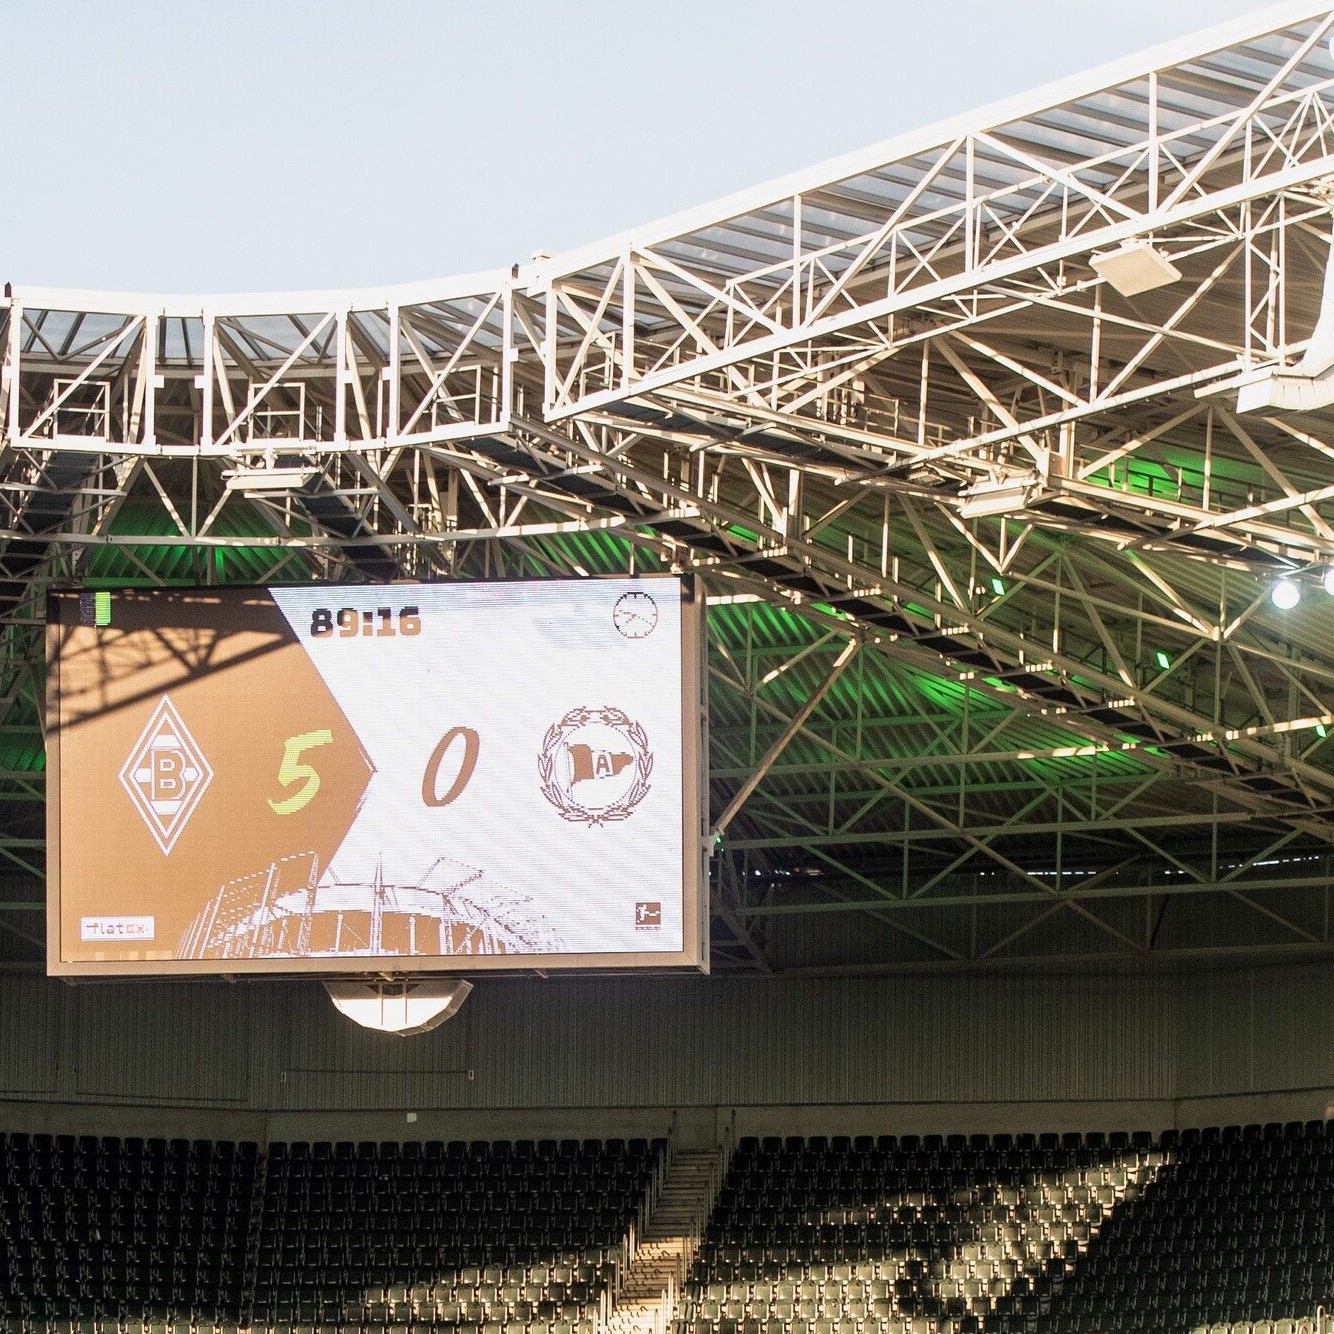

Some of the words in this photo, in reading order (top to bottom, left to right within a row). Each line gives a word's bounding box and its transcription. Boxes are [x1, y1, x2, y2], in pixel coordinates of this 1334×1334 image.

[310, 605, 422, 638] 89:16
[267, 729, 334, 815] 5
[422, 726, 480, 807] 0
